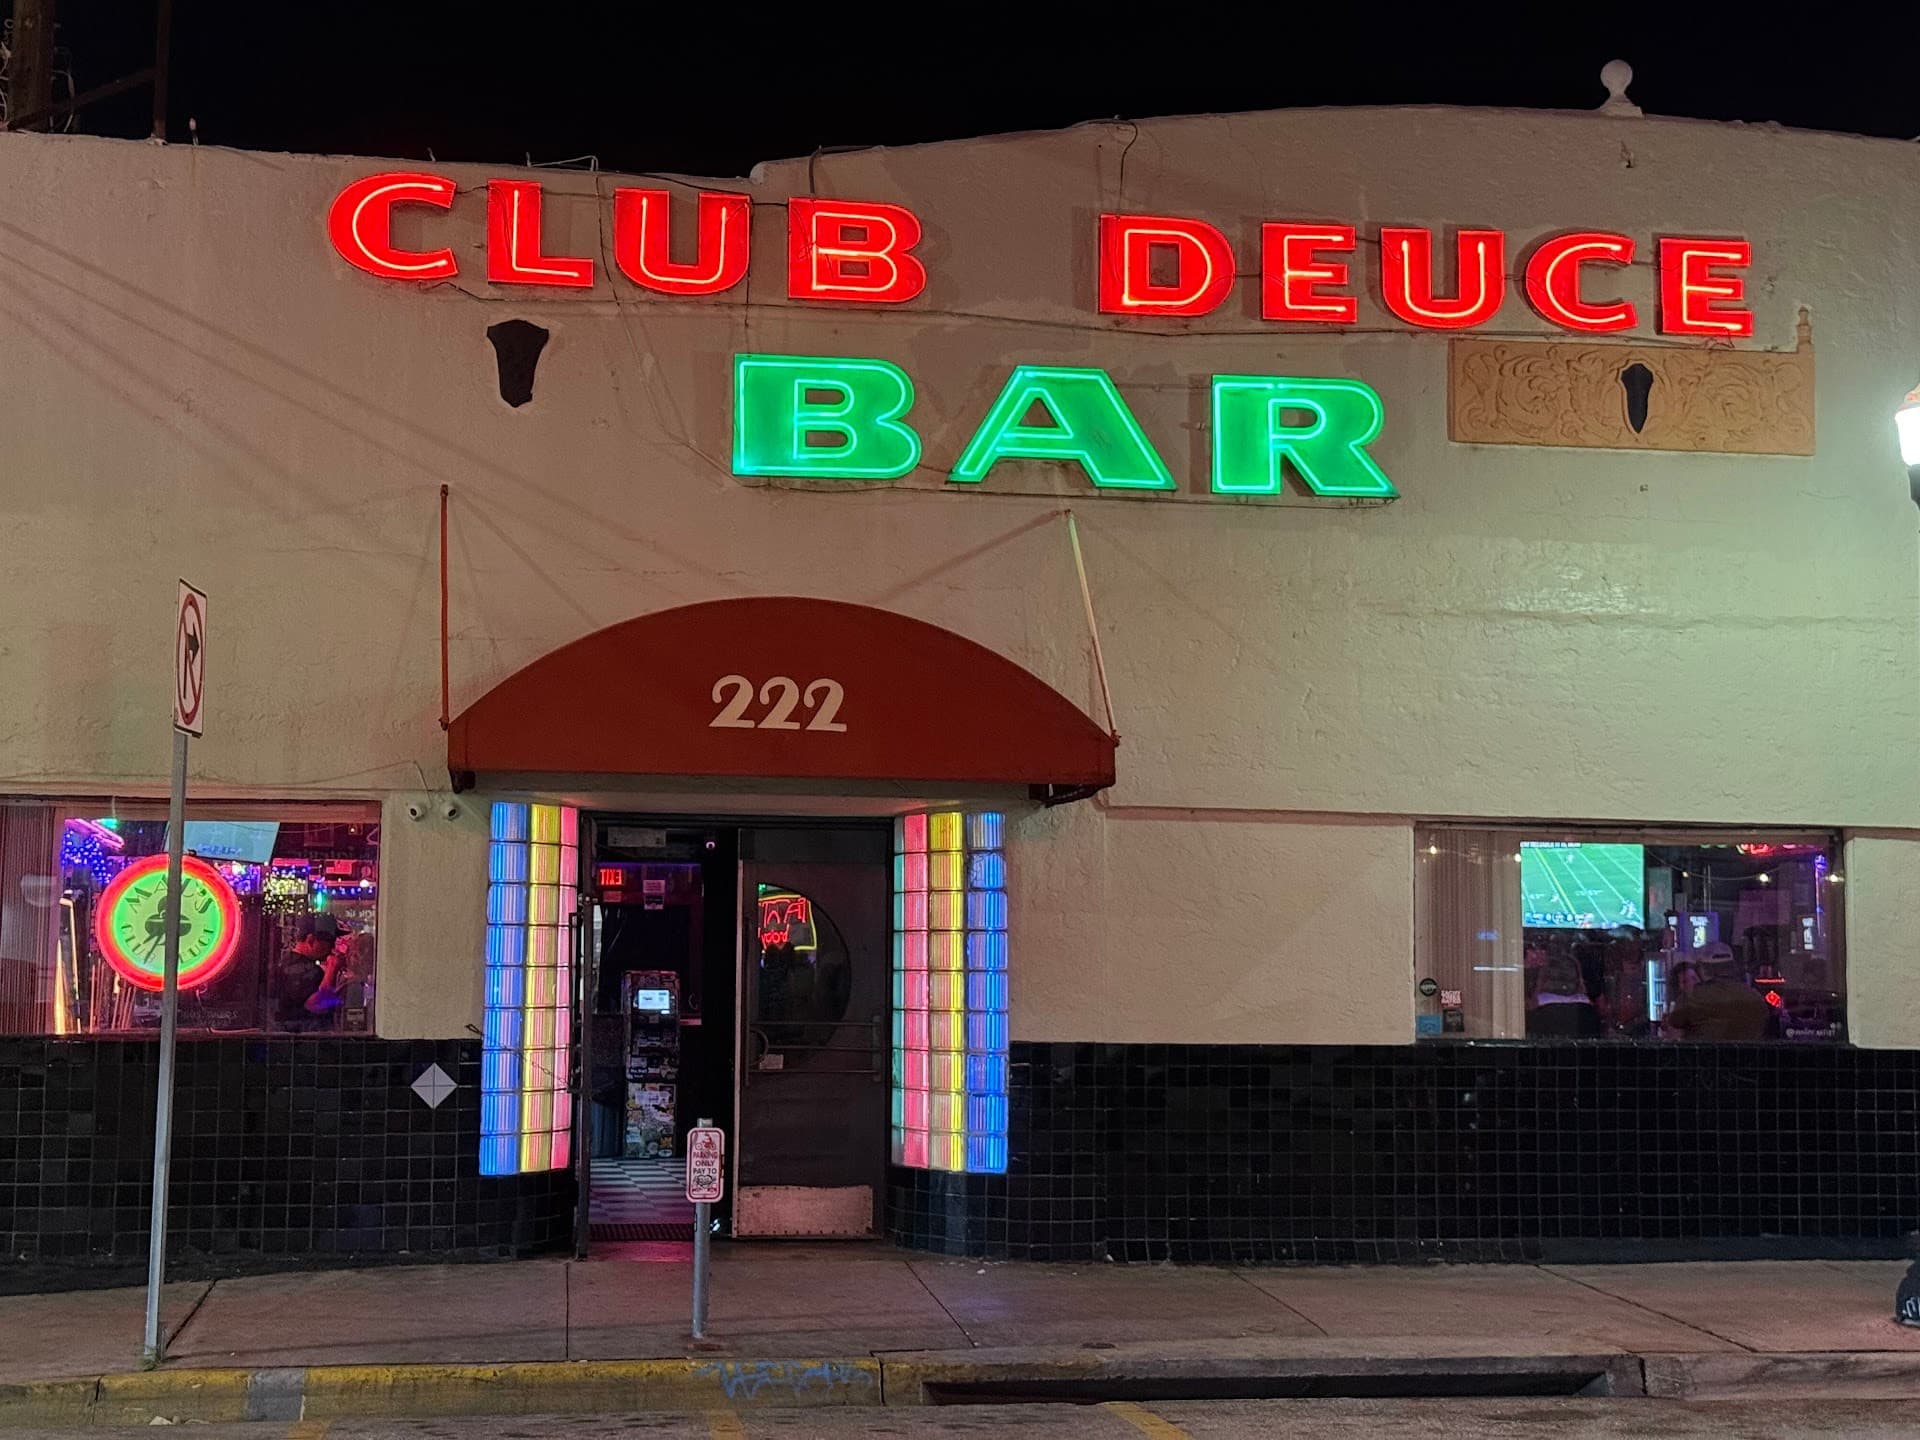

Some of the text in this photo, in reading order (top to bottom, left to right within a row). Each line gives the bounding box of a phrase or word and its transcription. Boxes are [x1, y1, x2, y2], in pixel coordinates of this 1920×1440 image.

[328, 171, 1754, 337] CLUB DEUCE
[731, 353, 1400, 498] BAR
[708, 674, 848, 732] 222
[693, 1151, 718, 1159] PARKING
[708, 1167, 717, 1175] TO
